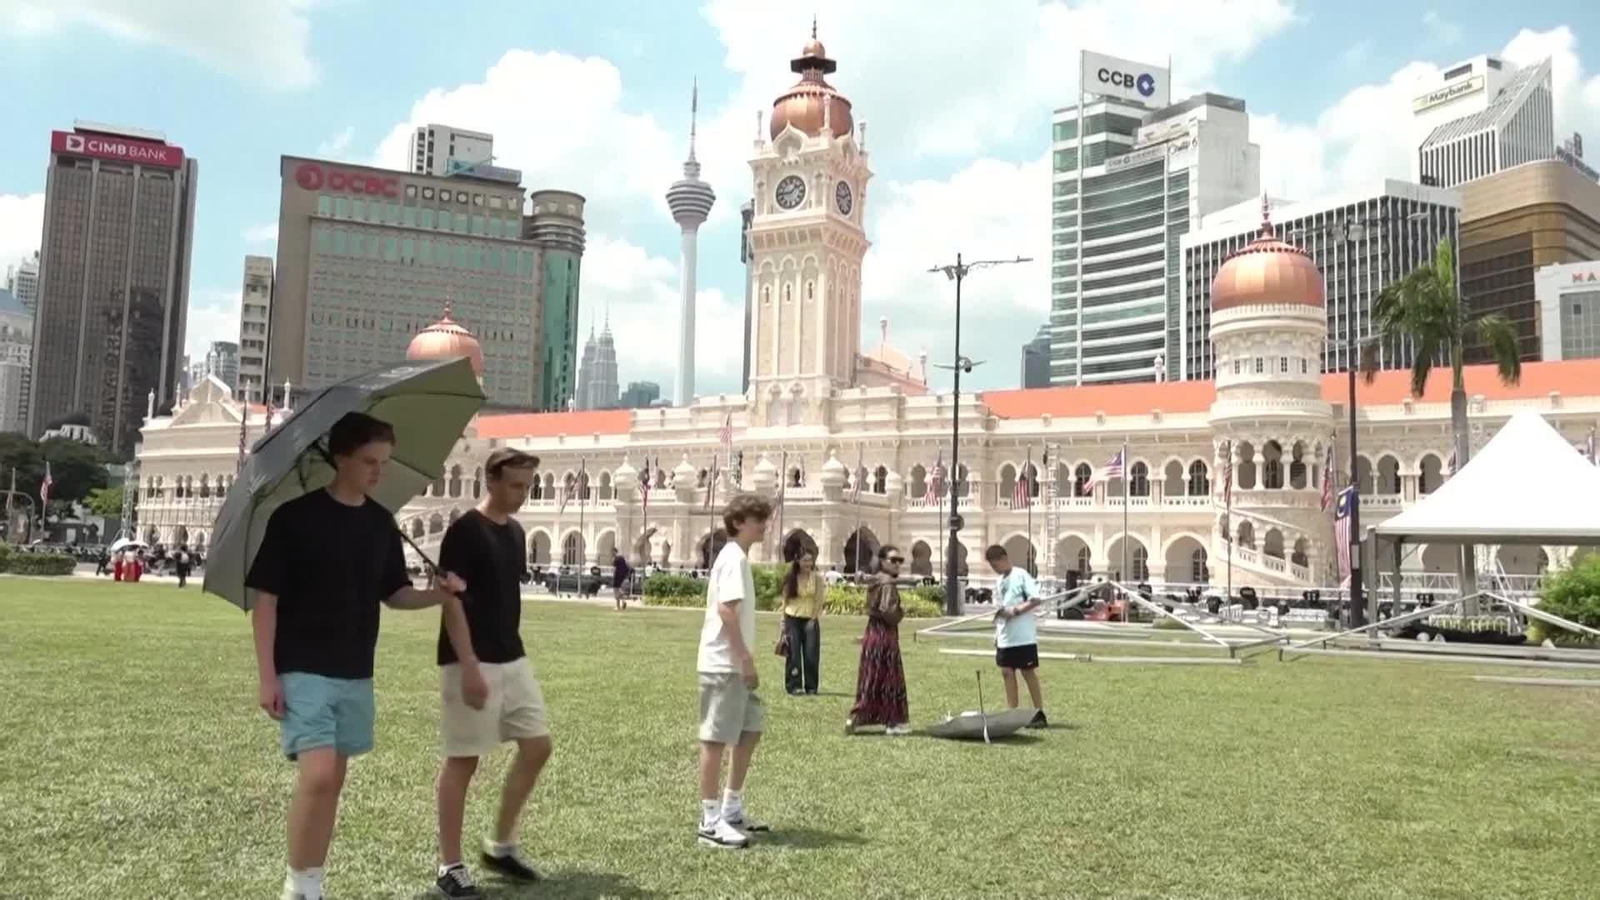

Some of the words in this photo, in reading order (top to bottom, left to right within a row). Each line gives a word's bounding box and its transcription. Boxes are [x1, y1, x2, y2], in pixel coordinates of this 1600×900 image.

[1097, 67, 1134, 88] CCB
[1429, 80, 1473, 102] Maybank
[88, 140, 127, 155] CIMB
[129, 146, 167, 161] BANK
[328, 171, 399, 198] OCBC
